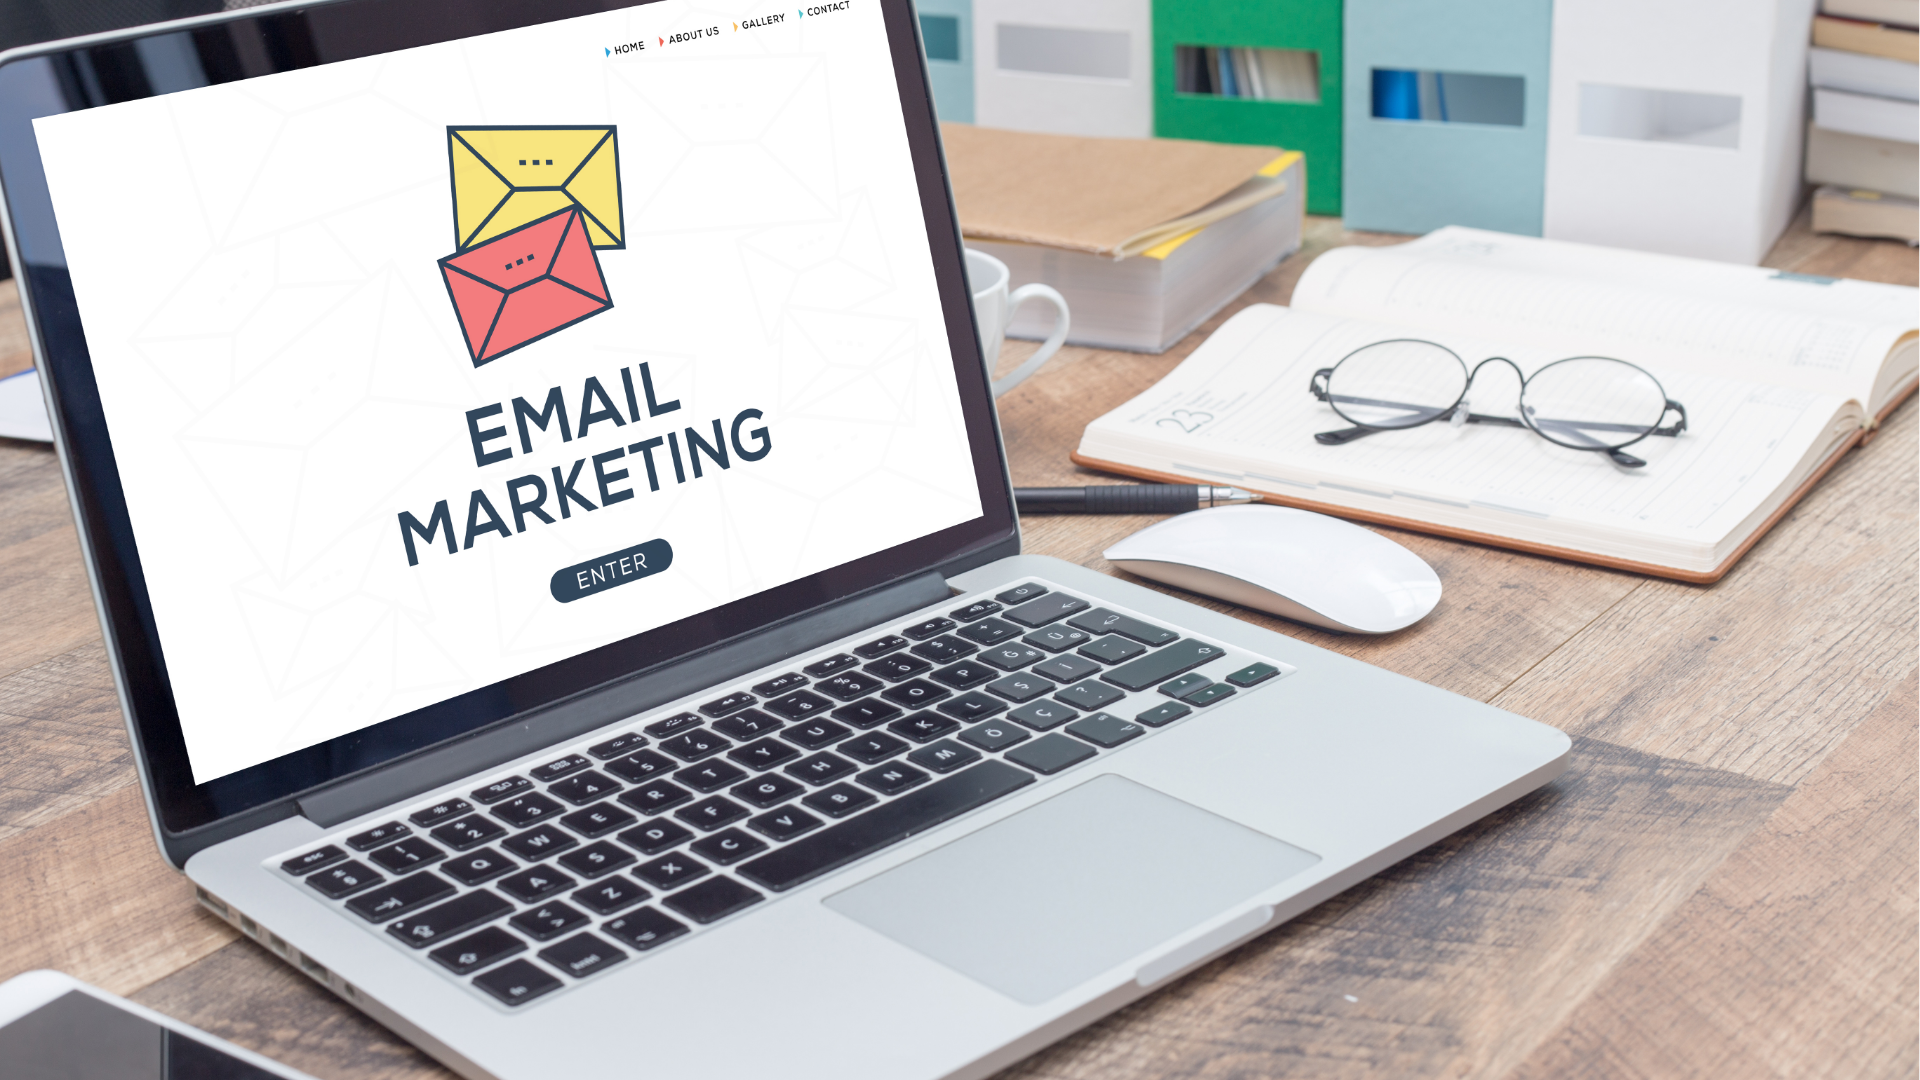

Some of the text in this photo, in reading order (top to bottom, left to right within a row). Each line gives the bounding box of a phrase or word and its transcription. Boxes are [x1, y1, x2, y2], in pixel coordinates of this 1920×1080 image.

[806, 1, 851, 17] CONTACT
[741, 13, 787, 30] GALLERY
[668, 26, 720, 45] ABOUT US
[613, 40, 646, 55] HOME
[464, 362, 682, 469] EMAIL
[397, 408, 773, 567] MARKETING
[576, 551, 648, 591] ENTER
[897, 664, 912, 673] 0
[956, 669, 969, 678] P
[849, 683, 861, 691] 9
[909, 688, 925, 697] O
[799, 703, 813, 711] 8
[965, 702, 983, 711] L
[746, 722, 759, 731] 7
[915, 719, 934, 730] K
[807, 726, 825, 736] U
[696, 743, 709, 751] 6
[869, 741, 882, 751] J
[755, 747, 771, 757] Y
[934, 749, 957, 761] M
[640, 763, 655, 772] 5
[811, 761, 831, 772] H
[701, 768, 717, 779] T
[882, 770, 903, 781] N
[586, 784, 599, 793] 4
[758, 783, 777, 794] G
[646, 790, 665, 800] R
[830, 793, 849, 804] B
[526, 806, 543, 816] 3
[703, 806, 718, 818] F
[590, 812, 608, 823] E
[775, 815, 793, 826] V
[466, 829, 484, 839] 2
[645, 829, 665, 840] D
[527, 834, 551, 847] W
[720, 838, 739, 850] C
[406, 853, 420, 861] 1
[588, 852, 606, 863] S
[470, 860, 492, 870] Q
[661, 862, 683, 875] X
[529, 877, 548, 888] A
[601, 886, 622, 900] Z
